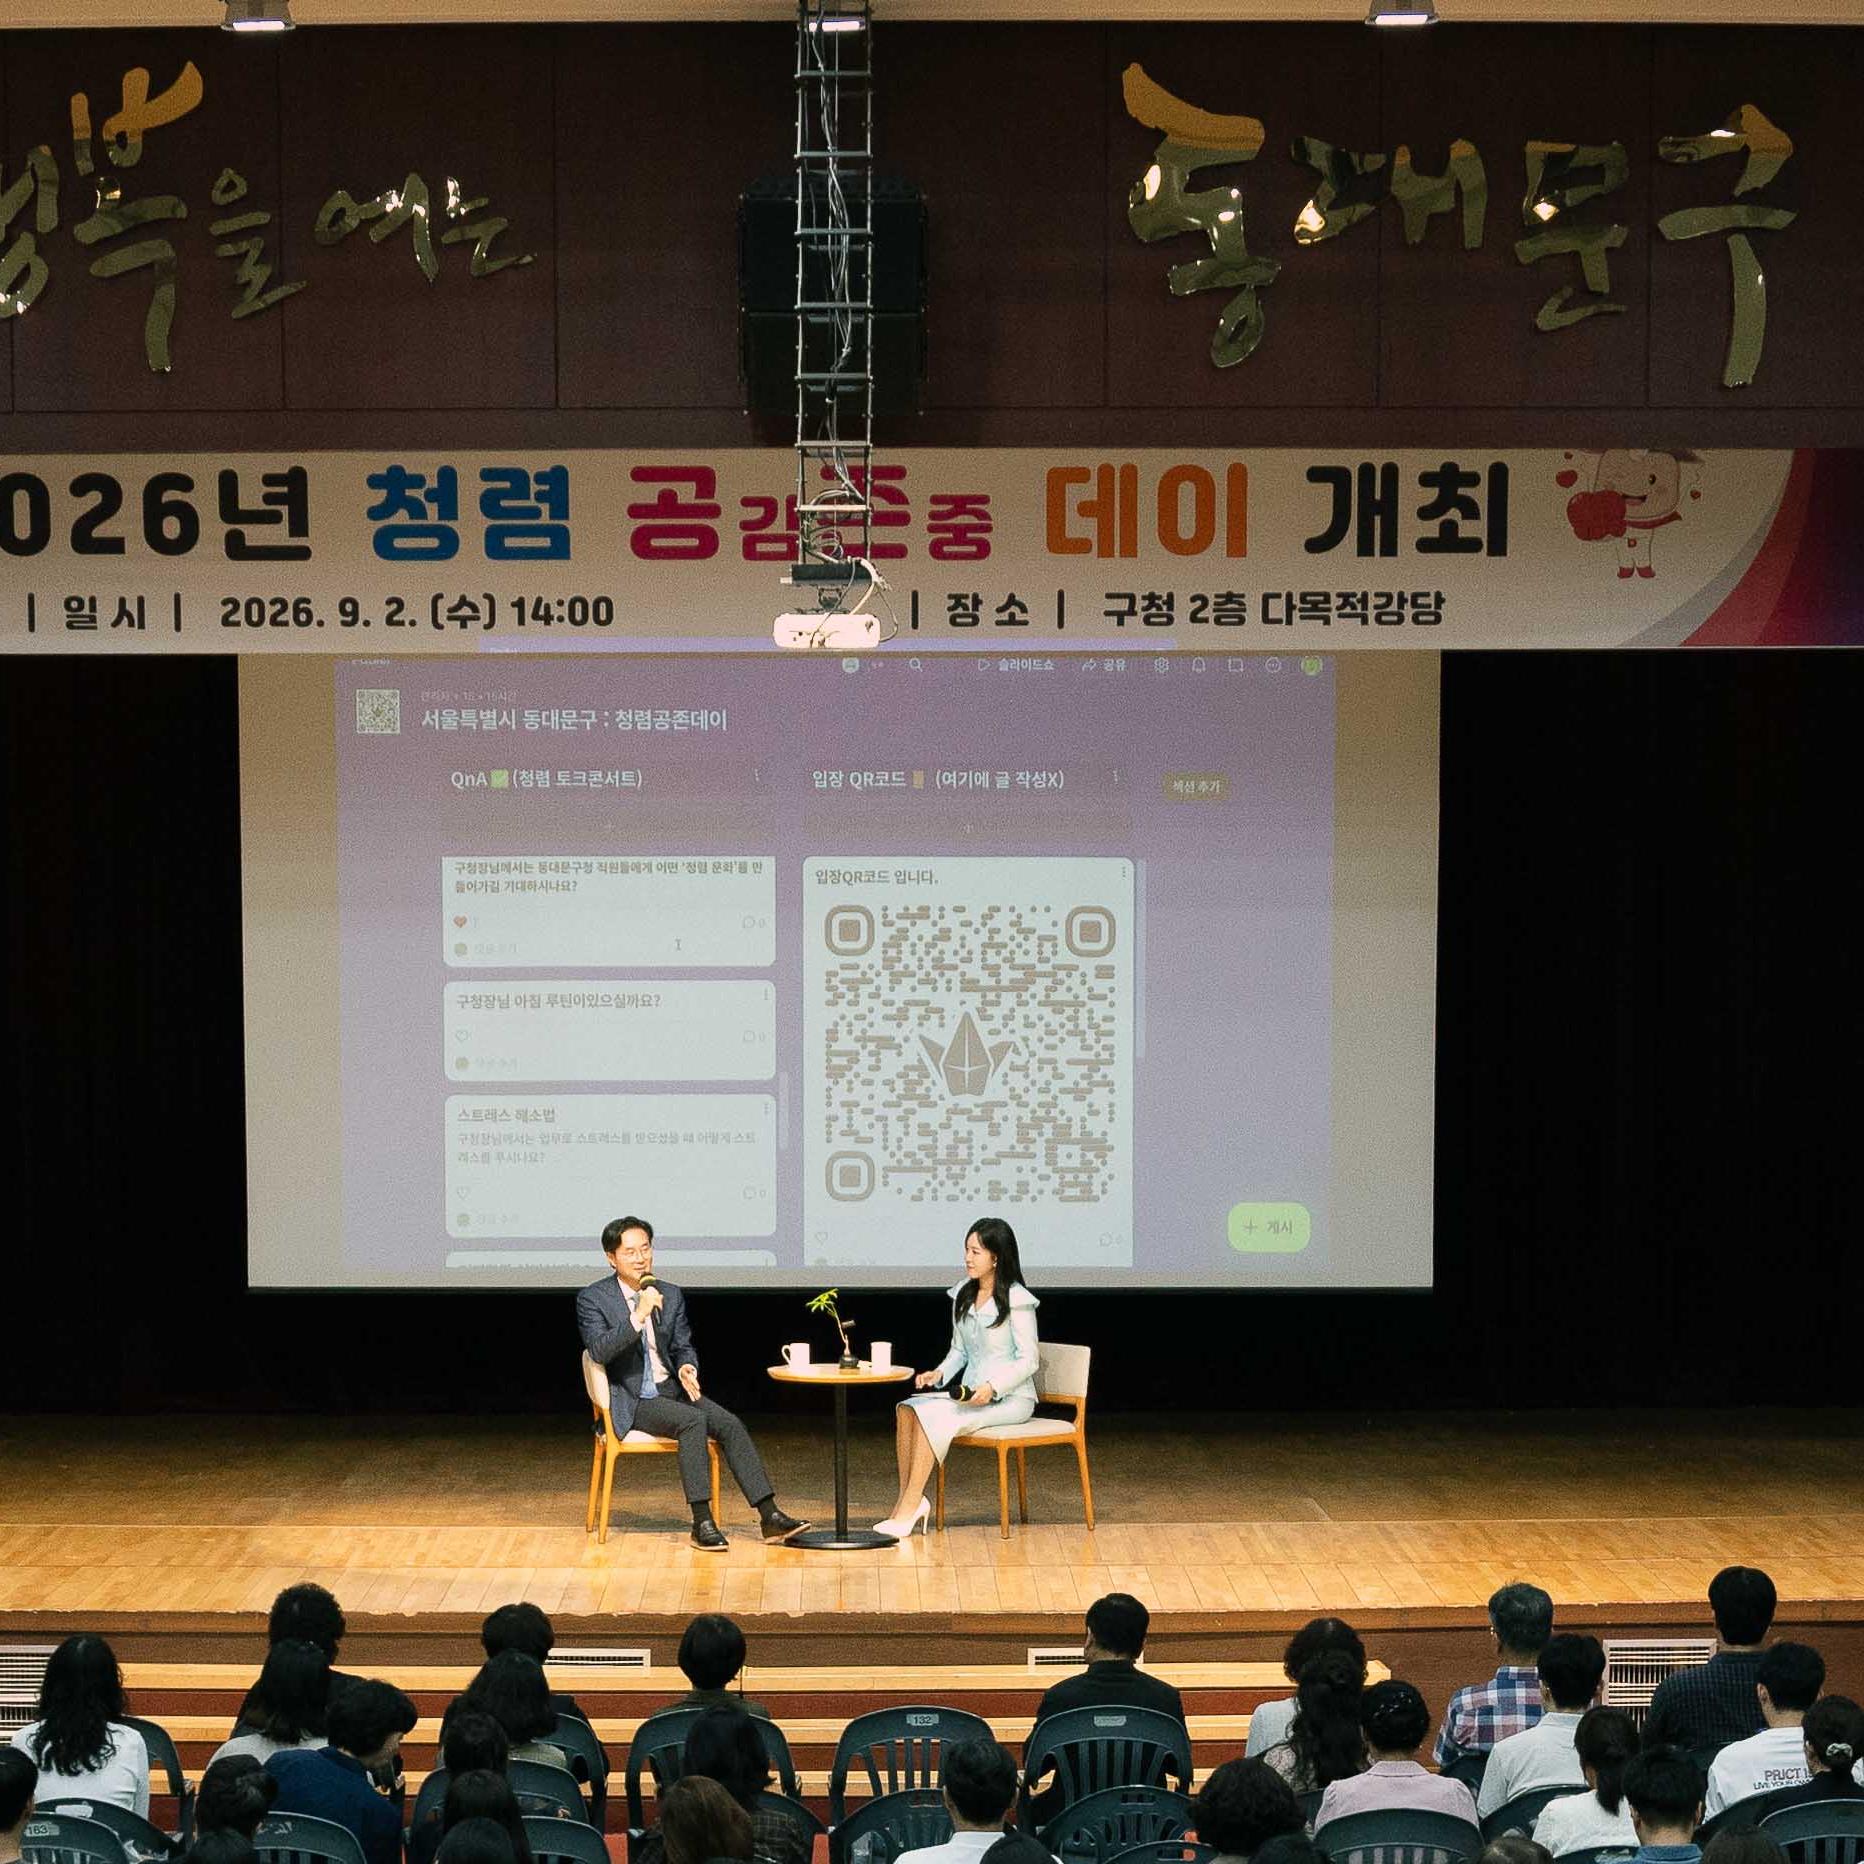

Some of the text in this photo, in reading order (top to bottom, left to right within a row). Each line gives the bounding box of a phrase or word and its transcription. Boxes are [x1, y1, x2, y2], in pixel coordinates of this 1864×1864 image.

[1123, 62, 1797, 387] 동대문구
[366, 464, 572, 562] 청렴
[1046, 462, 1247, 560] 데이
[1303, 461, 1509, 558] 개최
[220, 595, 326, 629] 2026.
[337, 595, 377, 629] 9.
[387, 595, 418, 629] 2.
[430, 592, 497, 632] (수)
[511, 594, 615, 628] 14:00
[1102, 592, 1178, 628] 구청
[1189, 591, 1249, 628] 2층
[1261, 590, 1445, 628] 다목적강당
[998, 657, 1055, 672] 슬라이드쇼
[1104, 657, 1127, 672] 공유
[422, 709, 516, 731] 서울특별시
[523, 709, 597, 731] 동대문구
[616, 709, 728, 731] 청렴공존데이
[451, 769, 643, 789] QnA (청렴 토크콘서트)
[812, 769, 1065, 790] 입장 QR코드 (여기에 글 작성X)
[1173, 779, 1221, 794] 섹션 추가
[538, 861, 593, 875] 동대문구청
[816, 869, 939, 886] 입장QR코드 입니다.
[504, 880, 578, 894] 기대하시나요?
[456, 993, 661, 1009] 구청장님 아침 루틴이있으실까요?
[457, 1108, 556, 1124] 스트레스 해소법
[1267, 1218, 1294, 1235] 게시
[913, 1714, 933, 1725] 132
